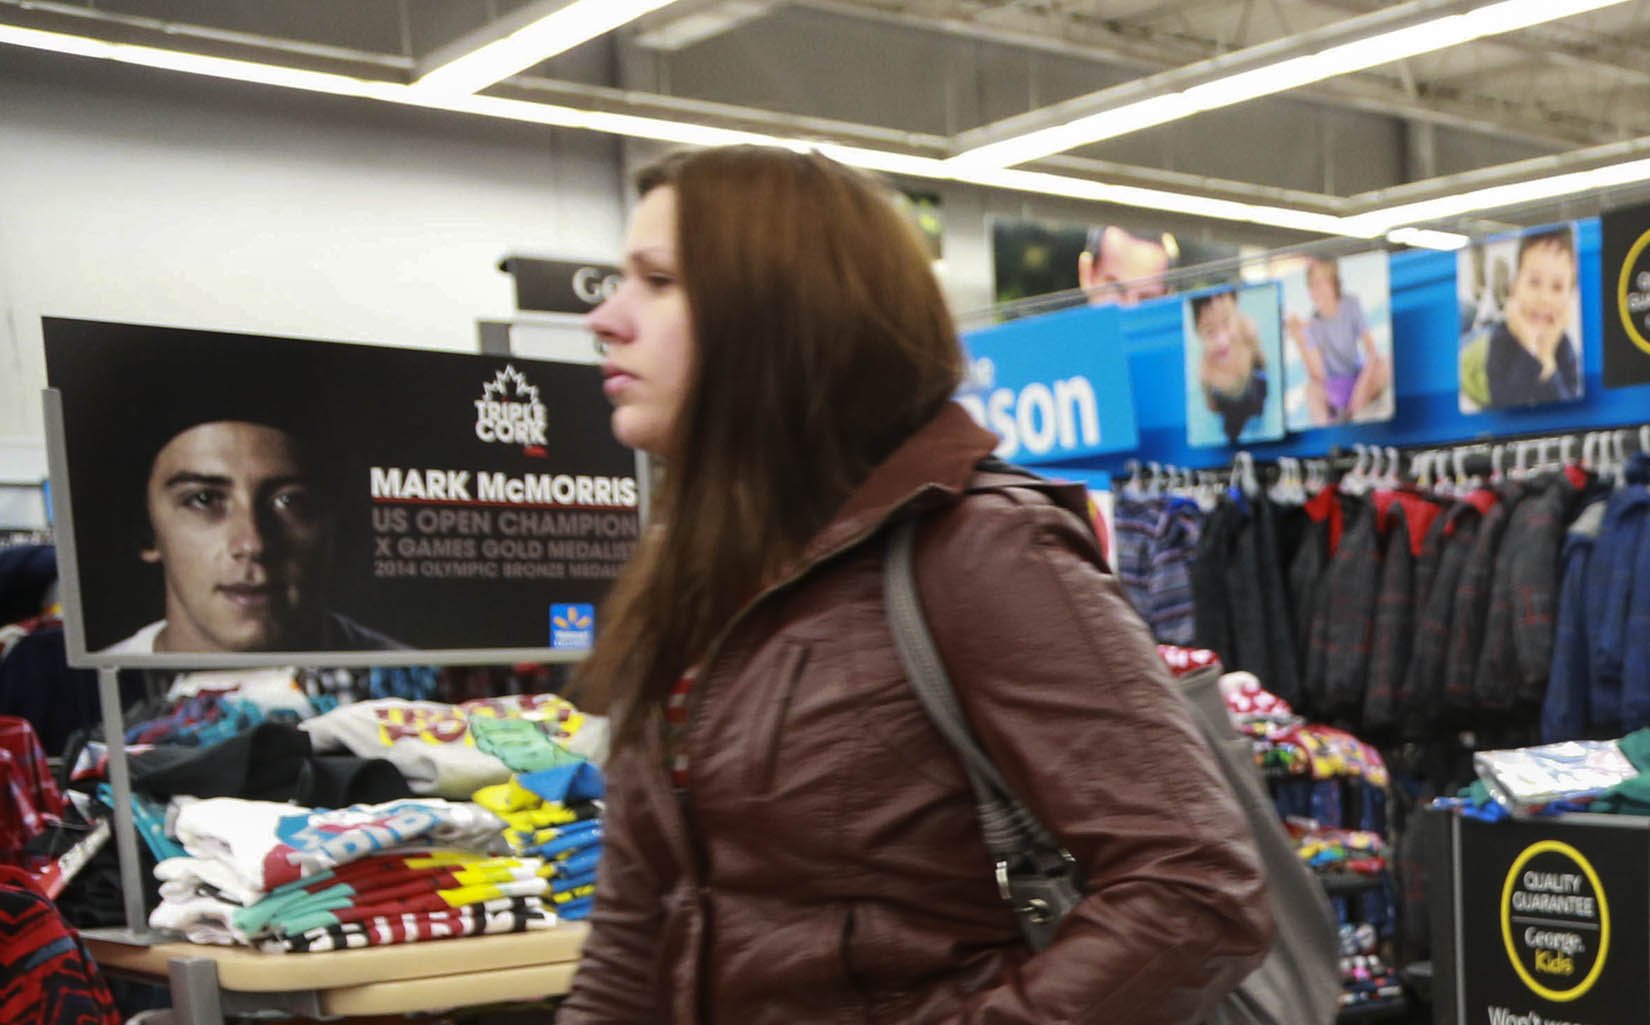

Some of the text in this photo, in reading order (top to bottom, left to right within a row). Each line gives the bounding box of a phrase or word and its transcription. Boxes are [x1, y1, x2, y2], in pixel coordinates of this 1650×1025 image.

[474, 419, 549, 445] CORK
[370, 466, 638, 507] MARK McMORRIS
[372, 507, 407, 533] US
[416, 509, 490, 535] OPEN
[376, 537, 392, 557] X
[397, 537, 478, 560] GAMES
[482, 539, 544, 561] GOLD
[374, 561, 417, 577] 2014
[420, 561, 499, 578] OLYMPIC
[1523, 870, 1583, 893] QUALITY
[1511, 890, 1595, 918] GUARANTEE
[1535, 949, 1576, 976] Kids
